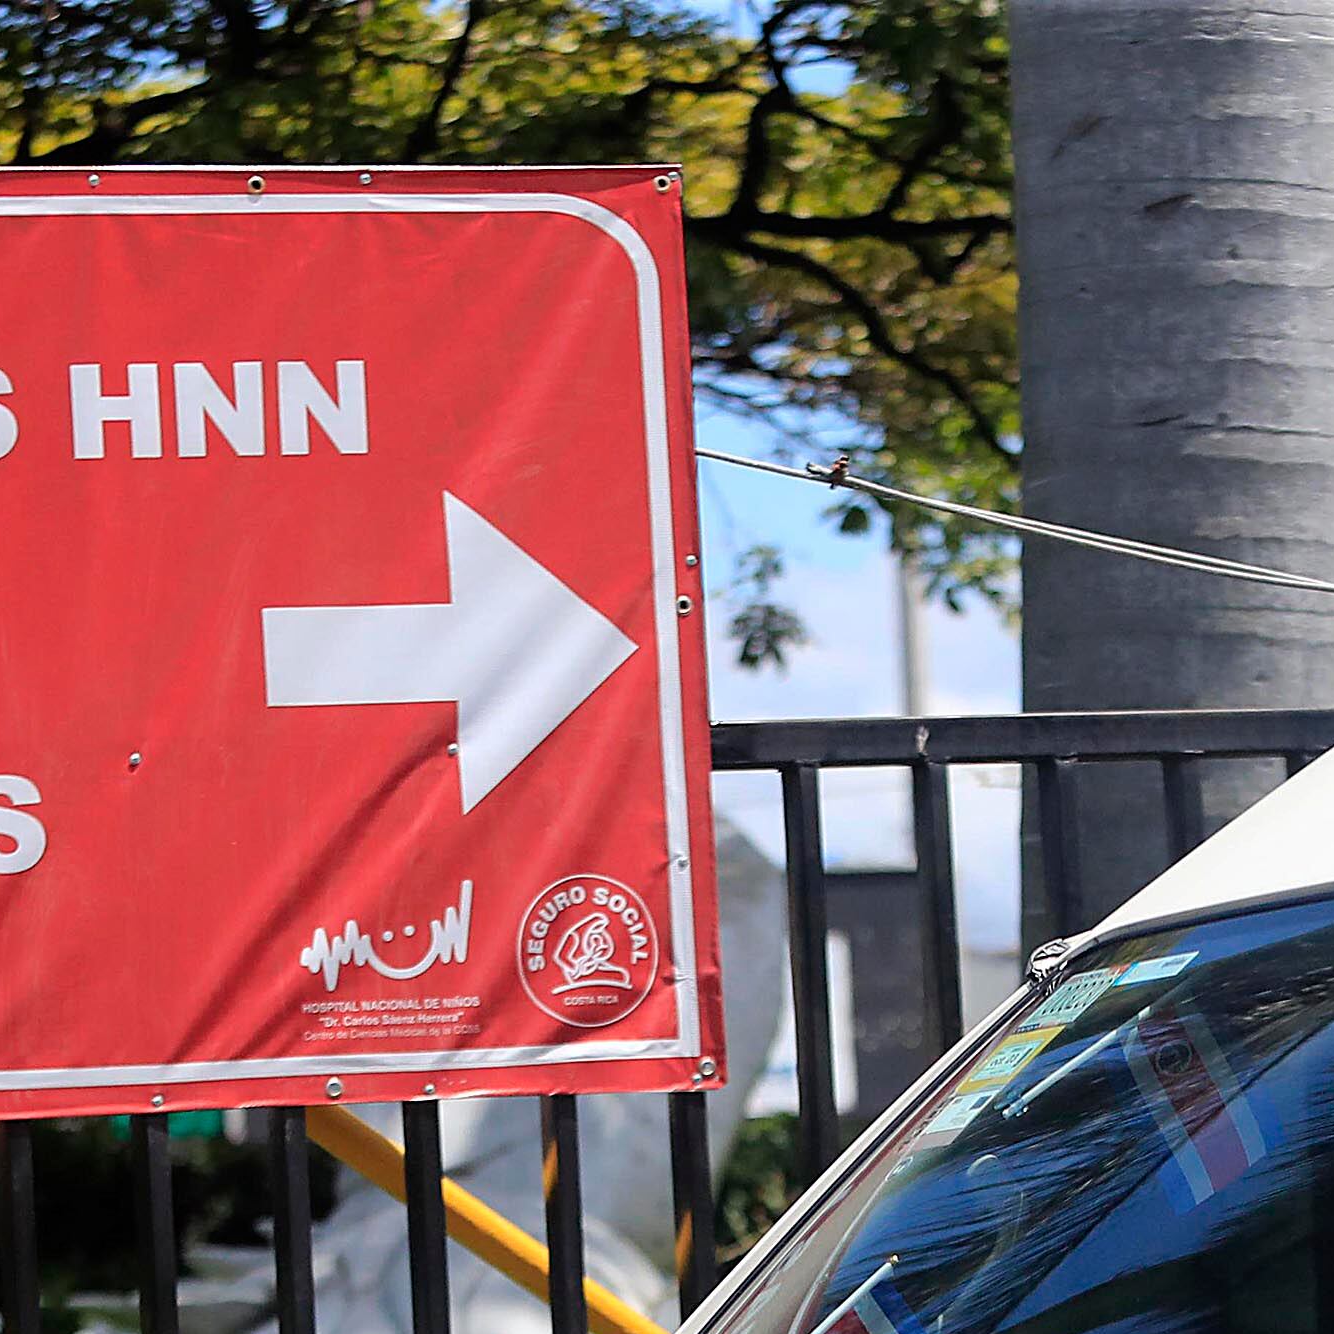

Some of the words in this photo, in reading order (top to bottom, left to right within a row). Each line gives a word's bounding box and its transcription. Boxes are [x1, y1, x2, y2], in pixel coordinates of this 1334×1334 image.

[69, 359, 369, 461] HNN
[527, 886, 586, 972] SEGURO
[593, 887, 649, 965] SOCIAL
[302, 1001, 359, 1014] HOSPITAL
[362, 999, 422, 1012] NACIONAL
[424, 998, 440, 1010] DE
[564, 996, 595, 1006] COSTA
[597, 995, 619, 1005] RICA
